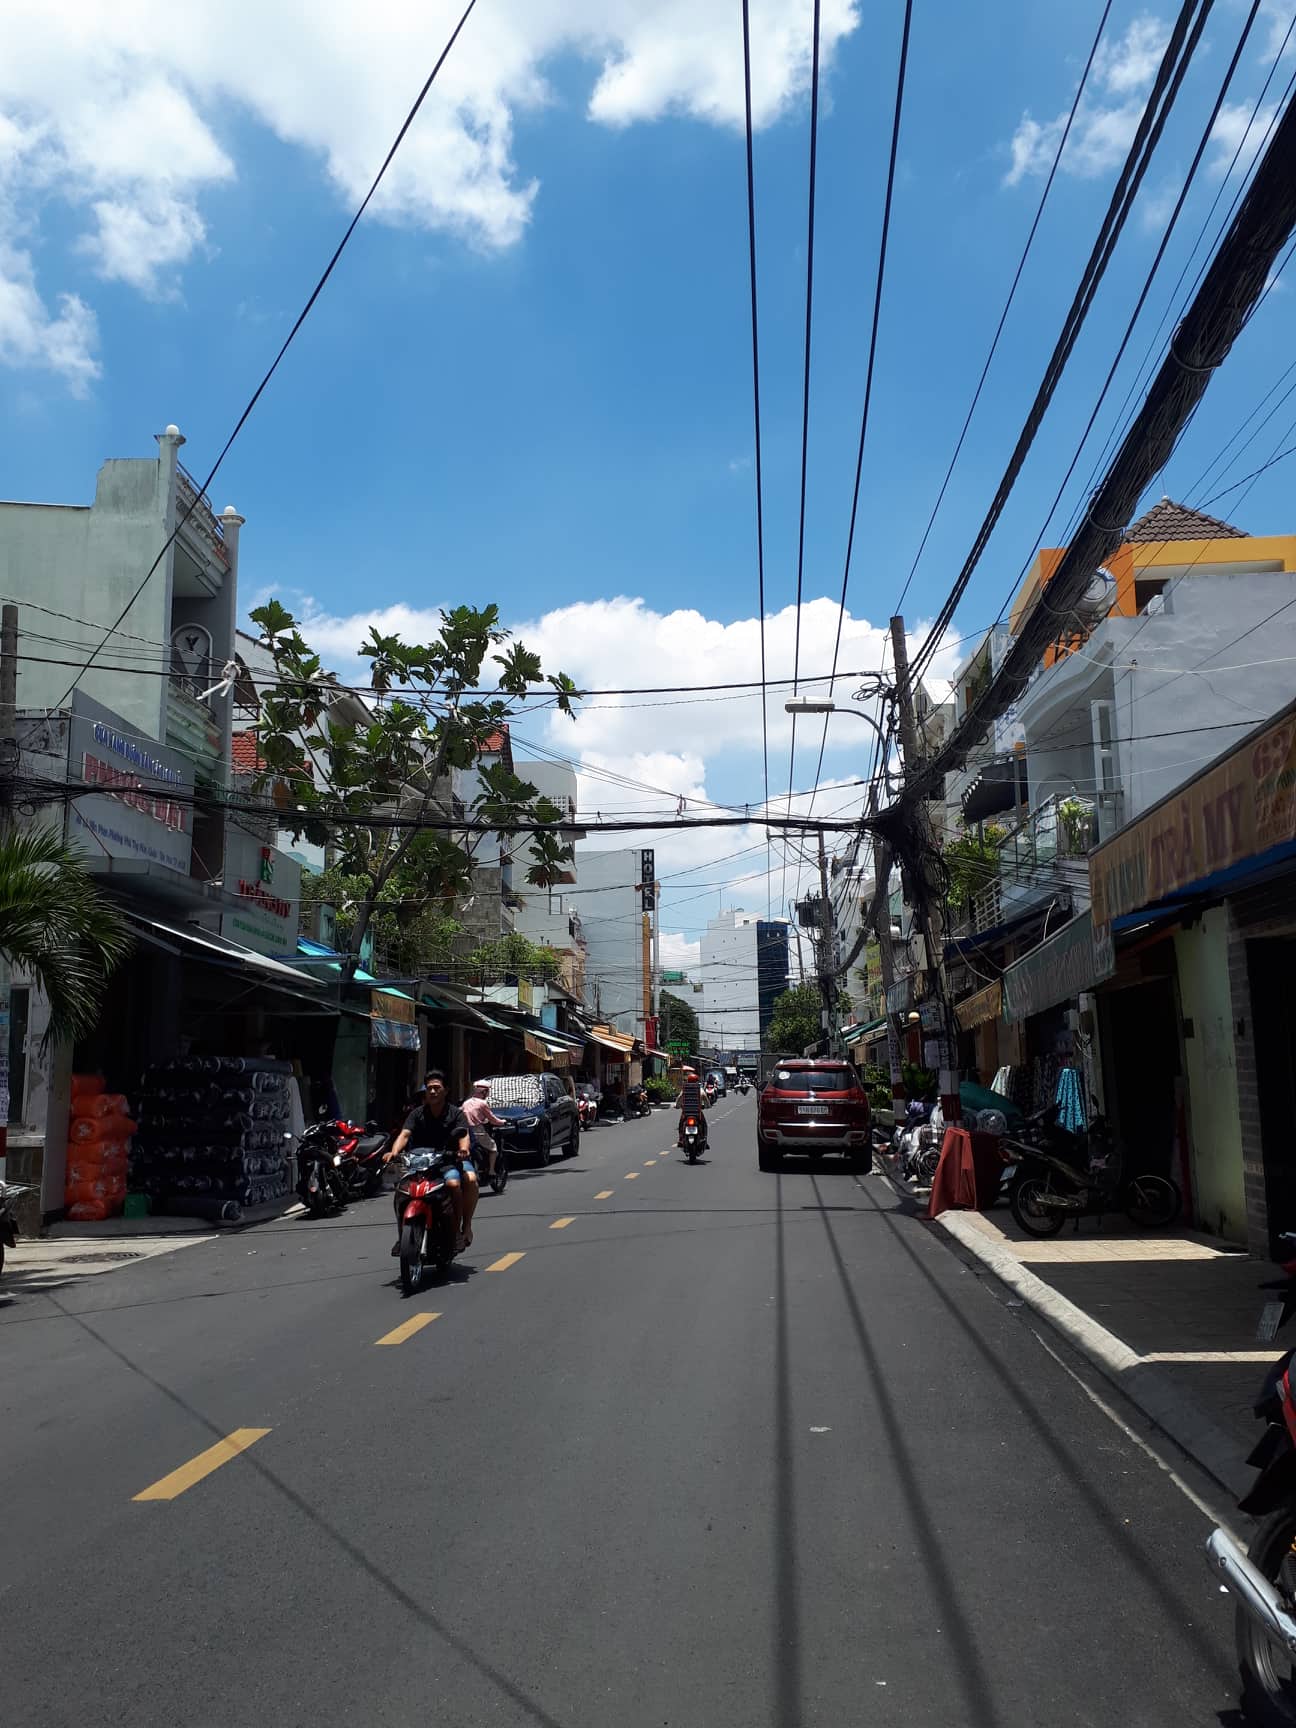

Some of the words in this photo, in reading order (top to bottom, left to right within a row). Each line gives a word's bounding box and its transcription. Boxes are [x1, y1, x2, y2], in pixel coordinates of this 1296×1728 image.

[1150, 799, 1196, 893] TRÀ
[1203, 782, 1244, 866] MY
[643, 851, 654, 909] HOTEL
